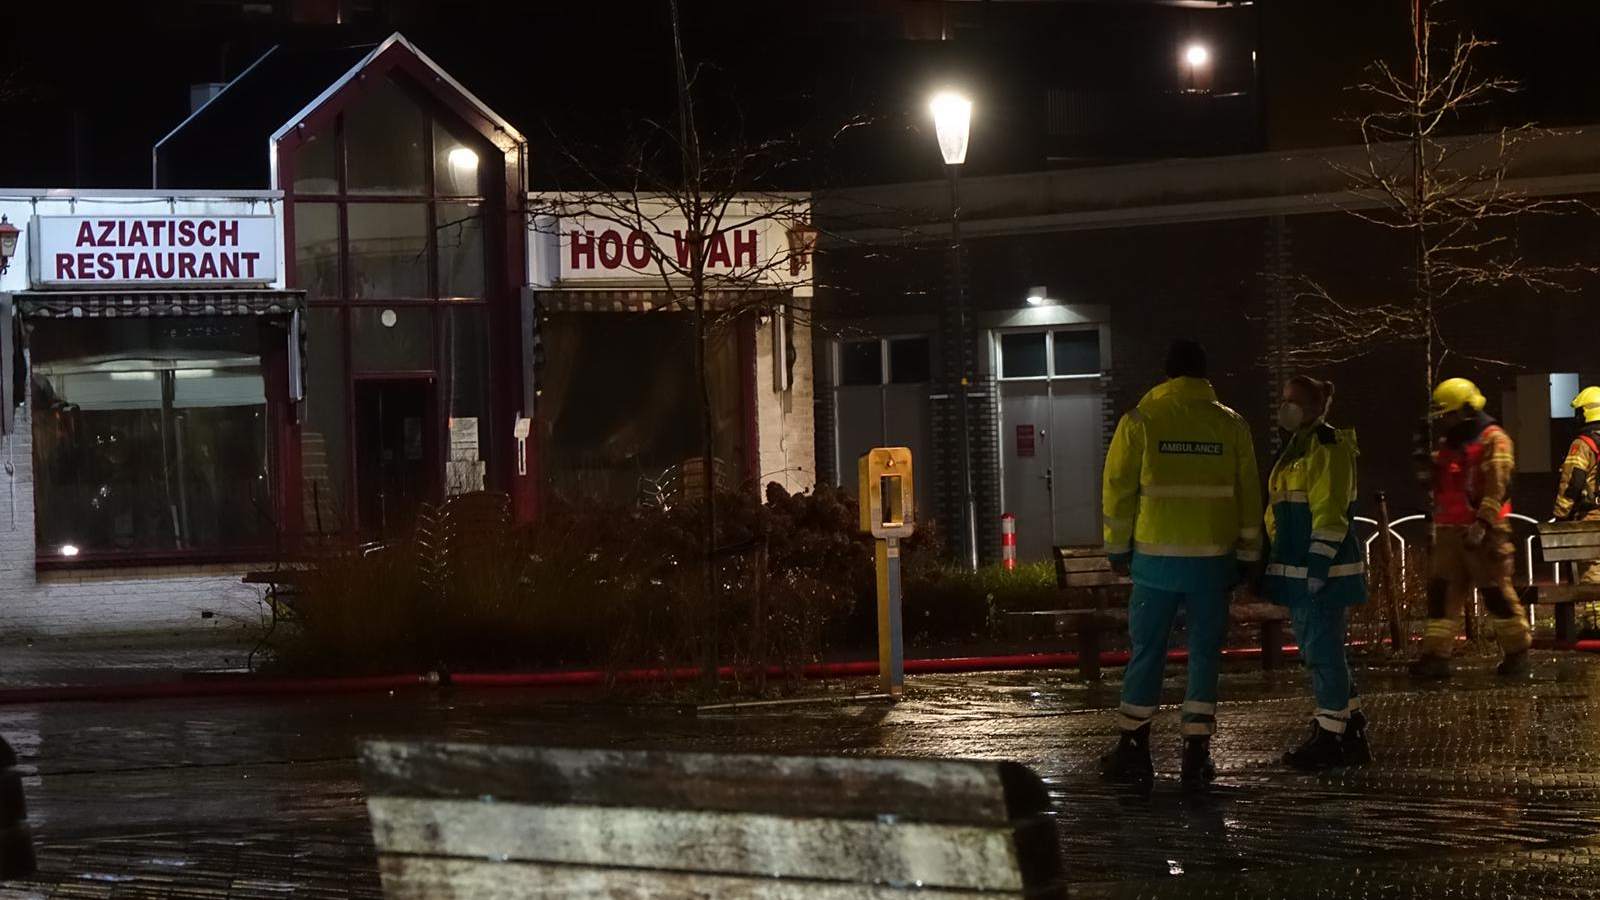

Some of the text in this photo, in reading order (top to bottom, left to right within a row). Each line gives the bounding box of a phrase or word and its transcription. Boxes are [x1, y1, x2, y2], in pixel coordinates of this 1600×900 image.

[76, 220, 239, 247] AZIATISCH
[571, 229, 651, 269] HOO
[56, 252, 260, 279] RESTAURANT
[1160, 442, 1221, 454] AMBULANCE
